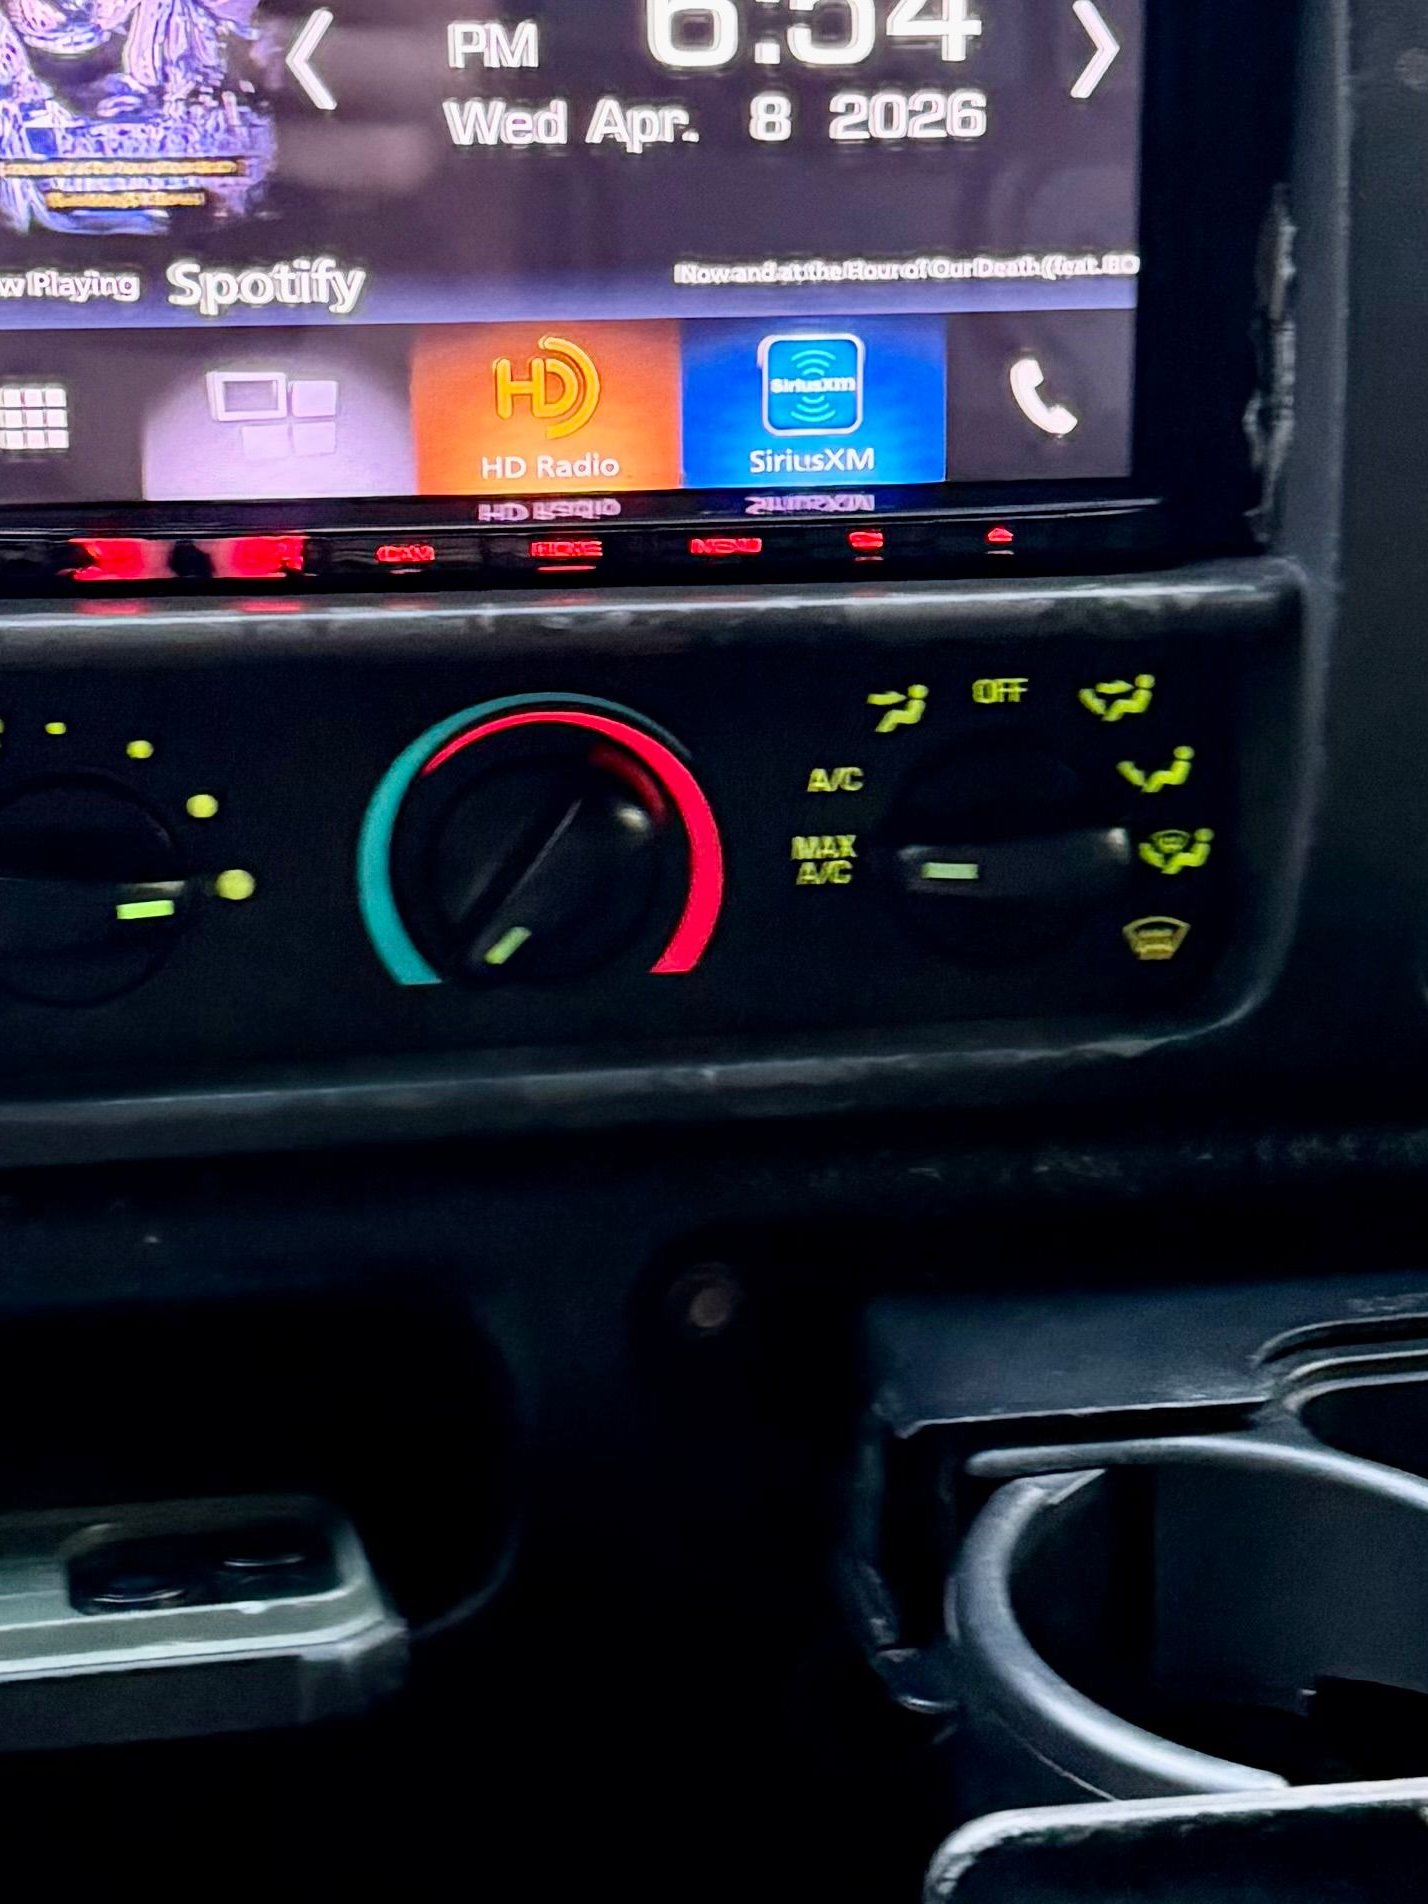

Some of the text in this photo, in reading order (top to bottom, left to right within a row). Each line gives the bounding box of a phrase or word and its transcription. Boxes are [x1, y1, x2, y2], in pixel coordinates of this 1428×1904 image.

[446, 20, 541, 69] PM
[442, 91, 989, 155] Wed Apr. 8 2026
[26, 268, 142, 303] Playing
[165, 256, 367, 316] Spotify
[673, 262, 732, 284] Now
[481, 452, 620, 480] HD Radio
[749, 447, 876, 474] SiriusXM
[972, 677, 1029, 703] OFF
[806, 767, 864, 792] A/C
[791, 835, 858, 860] MAX
[795, 860, 853, 885] A/C
